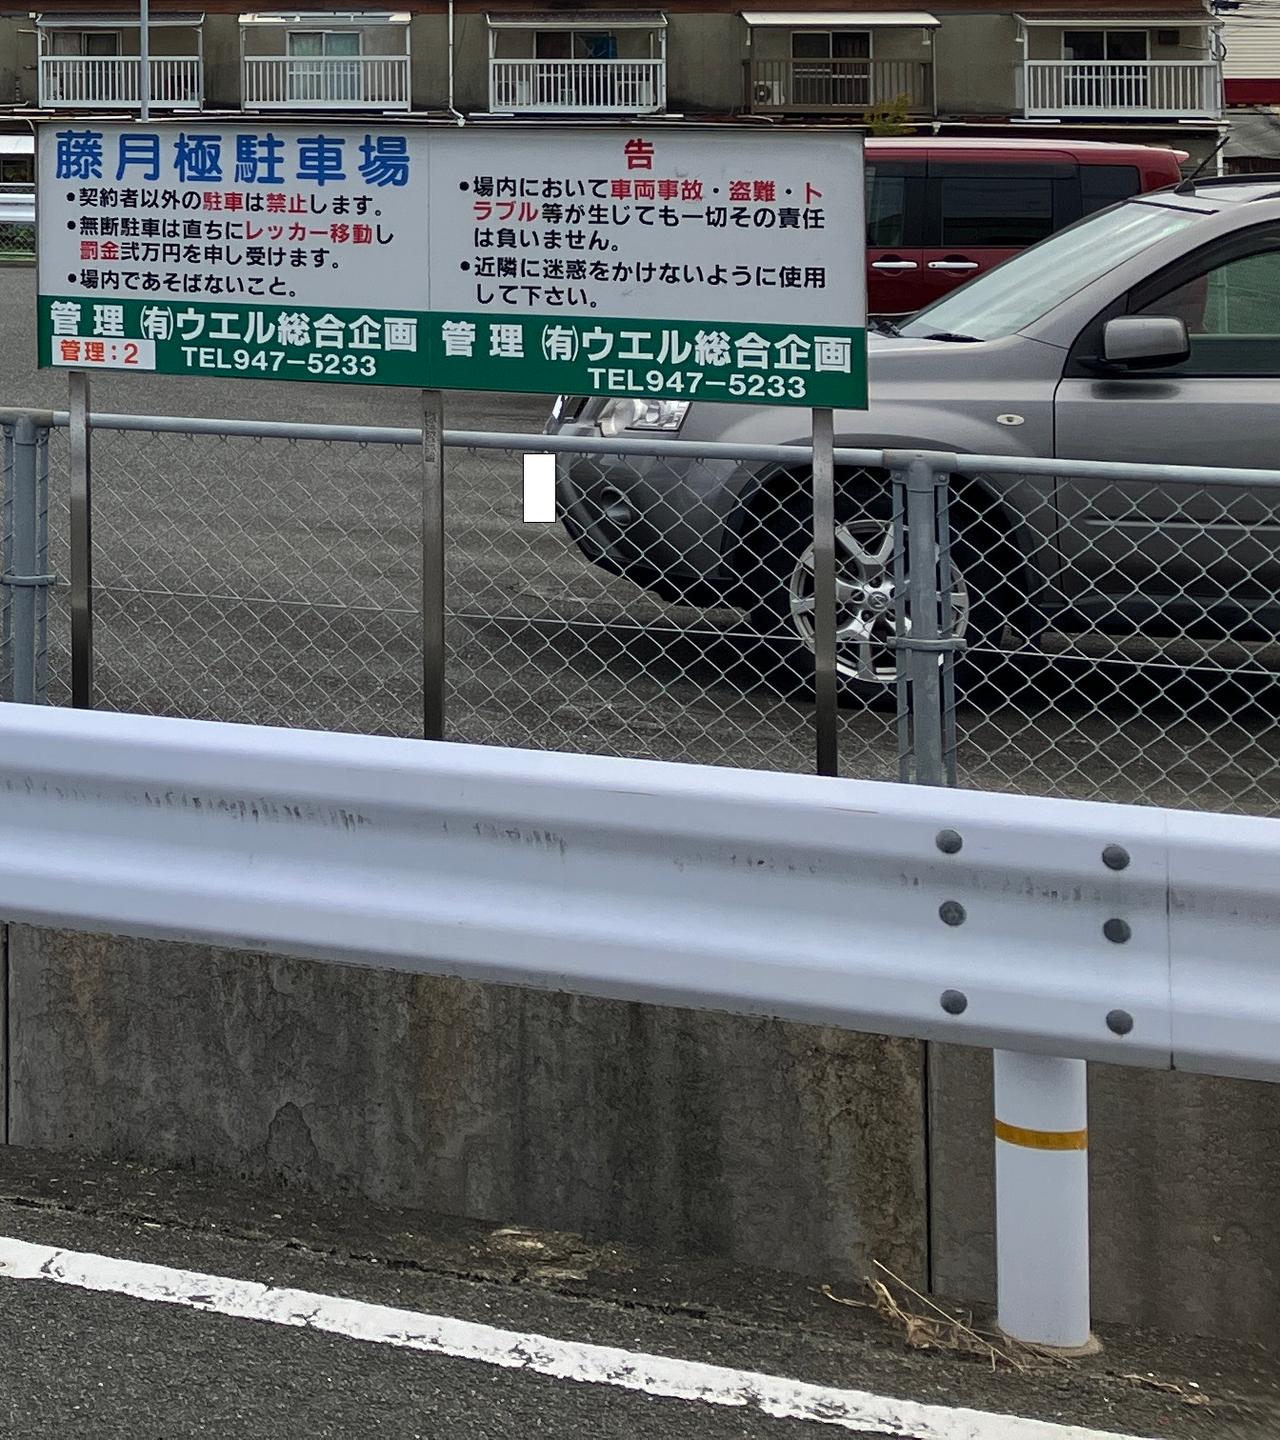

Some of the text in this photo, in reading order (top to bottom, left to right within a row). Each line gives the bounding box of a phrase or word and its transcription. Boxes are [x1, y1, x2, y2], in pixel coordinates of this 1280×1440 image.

[54, 128, 411, 188] 藤月極駐車場
[623, 137, 655, 171] 告
[78, 187, 383, 217] 契約者以外の駐車は禁止します。
[472, 175, 823, 205] 場内において車両事故・盗難・ト
[78, 215, 395, 245] 無断駐車は直ちにレッカー移動し
[472, 201, 826, 230] ラブル等が生じても一切その責任
[79, 240, 340, 269] 罰金弐万円を申し受けます。
[473, 227, 619, 252] は負いません。
[79, 268, 297, 298] 場内であそばないこと。
[473, 255, 827, 289] 近隣に迷惑をかけないように使用
[475, 283, 598, 309] して下さい。
[49, 299, 126, 337] 管理
[440, 319, 525, 358] 管理
[179, 346, 377, 377] TEL947-5233
[586, 367, 807, 399] TEL947-5233
